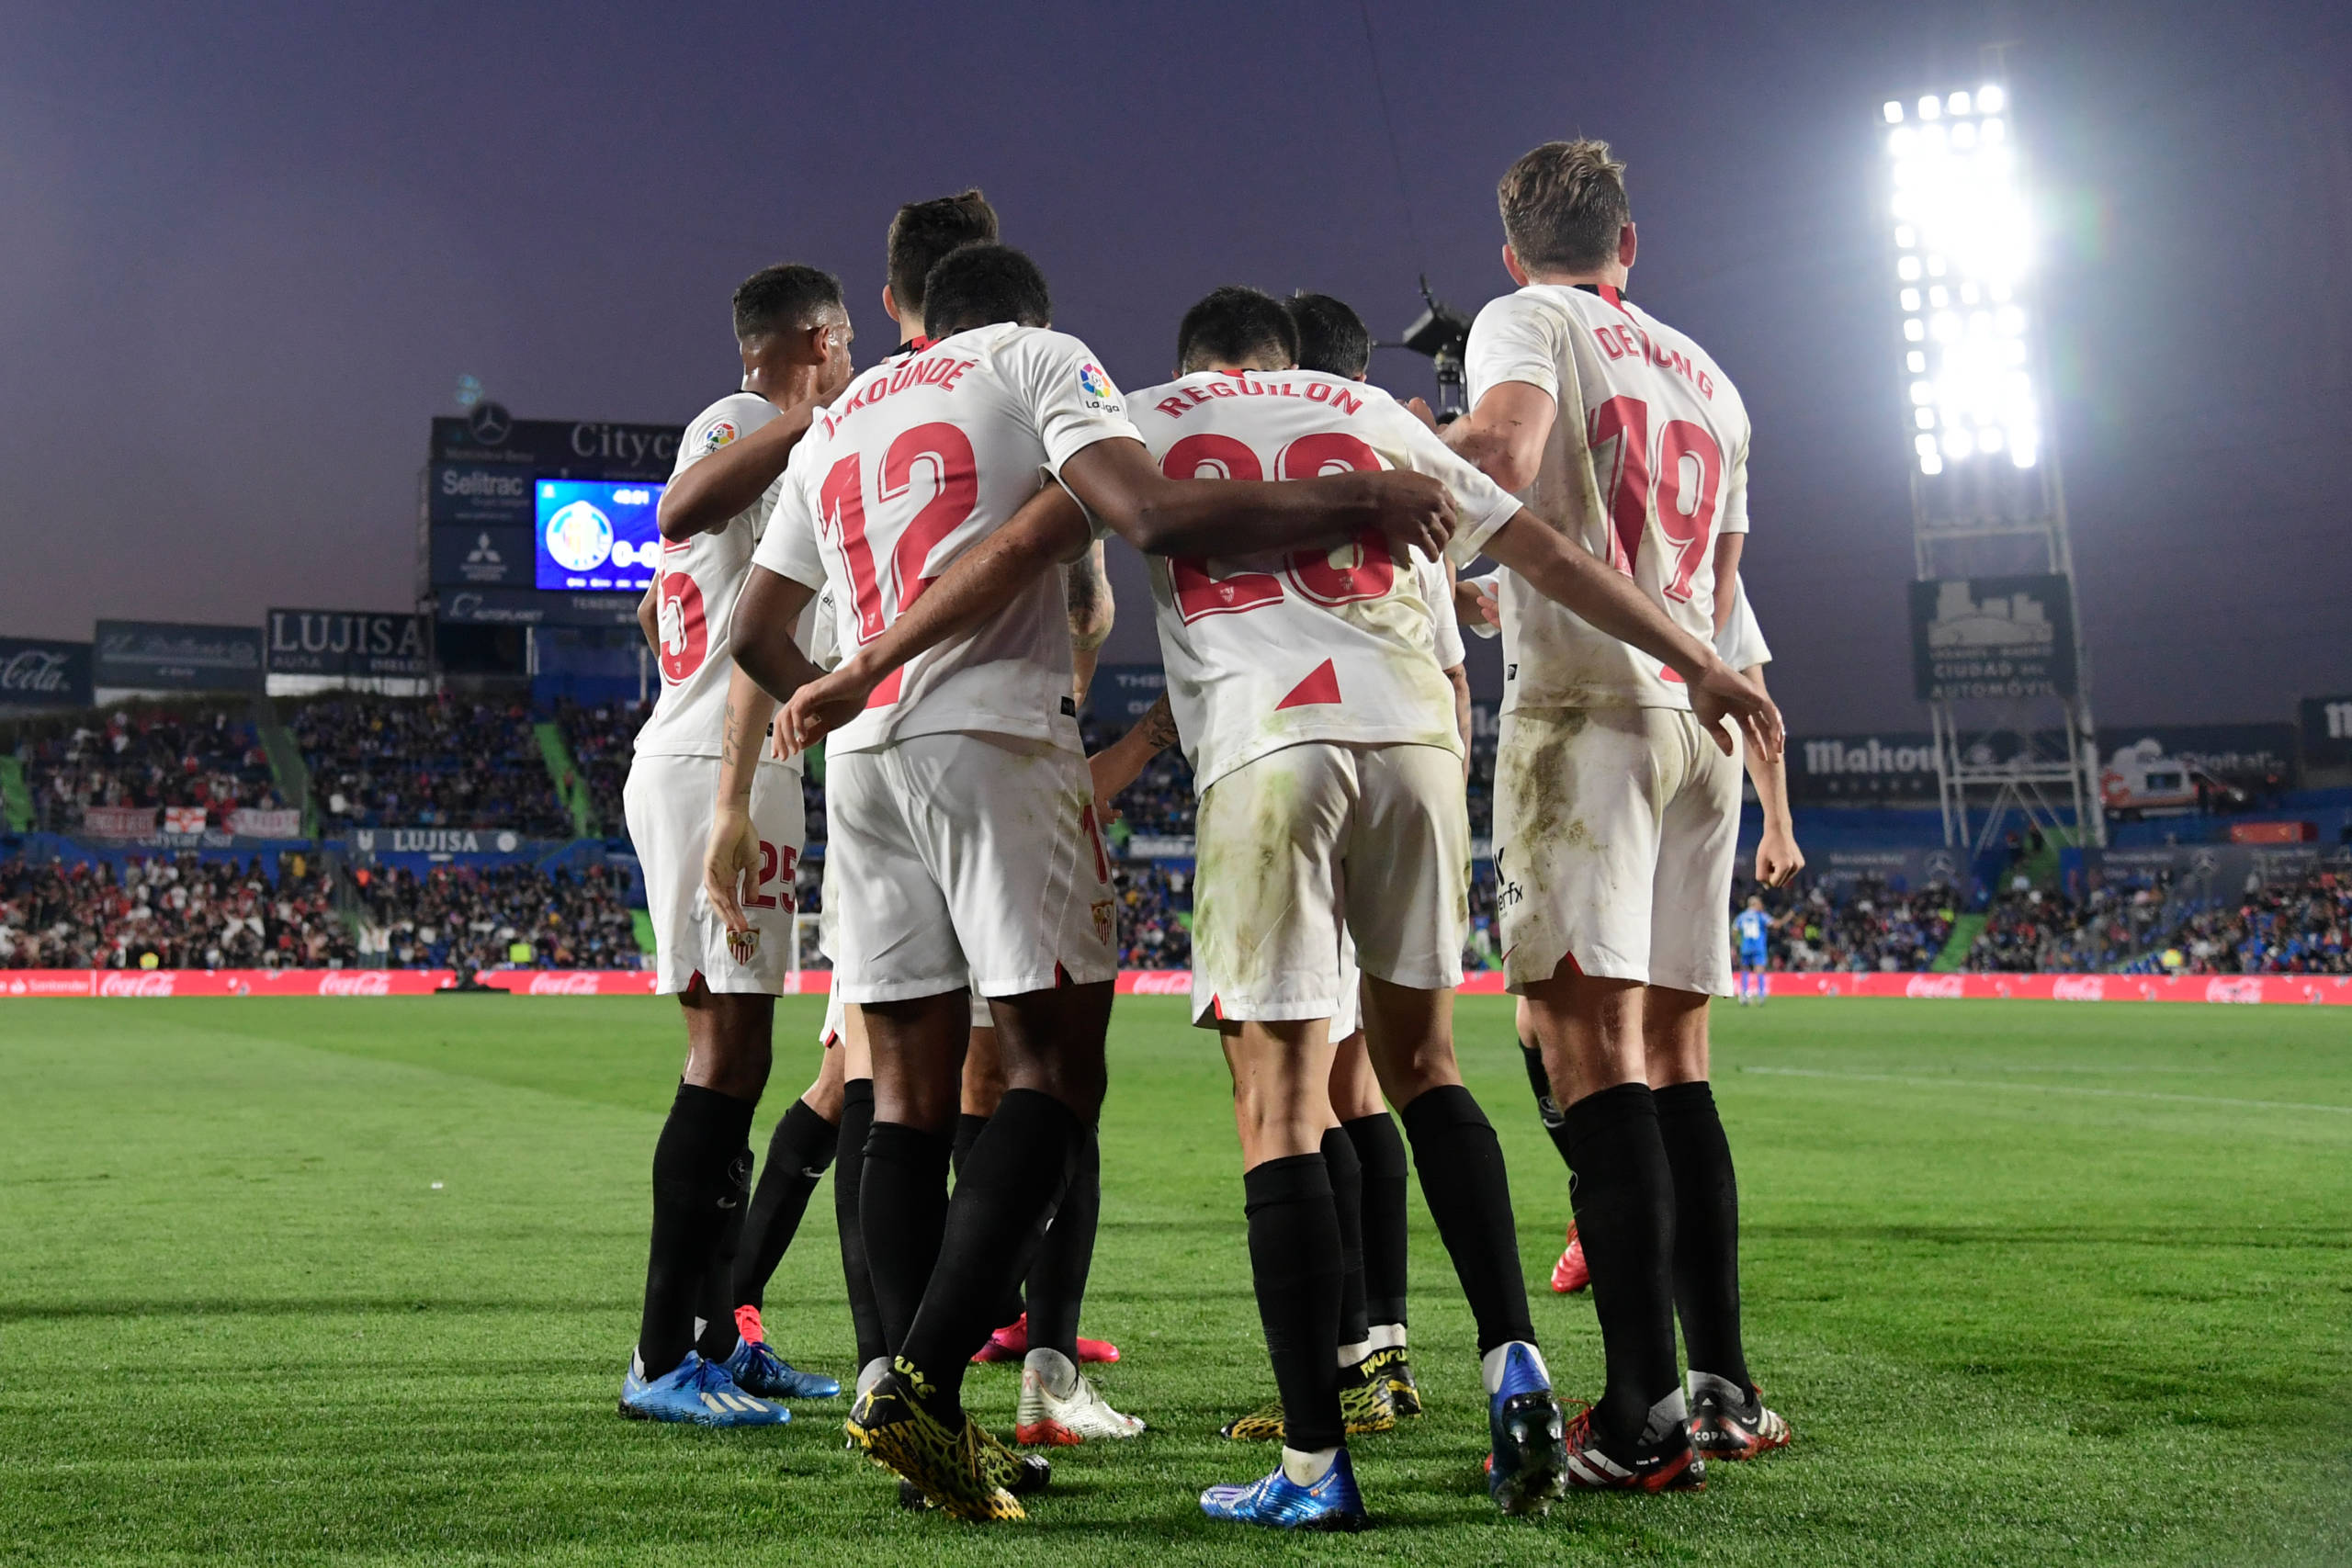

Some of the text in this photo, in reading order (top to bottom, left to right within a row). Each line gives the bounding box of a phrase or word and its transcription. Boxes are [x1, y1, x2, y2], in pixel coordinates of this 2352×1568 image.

[571, 423, 679, 468] Cityc
[1588, 393, 1722, 604] 19
[817, 422, 978, 647] 12
[1158, 432, 1395, 627] 23
[271, 612, 426, 656] LUJISA
[393, 830, 479, 852] LUJISA
[29, 978, 89, 994] Santander
[1694, 1431, 1729, 1441] COPA
[1690, 1461, 1705, 1473] CO
